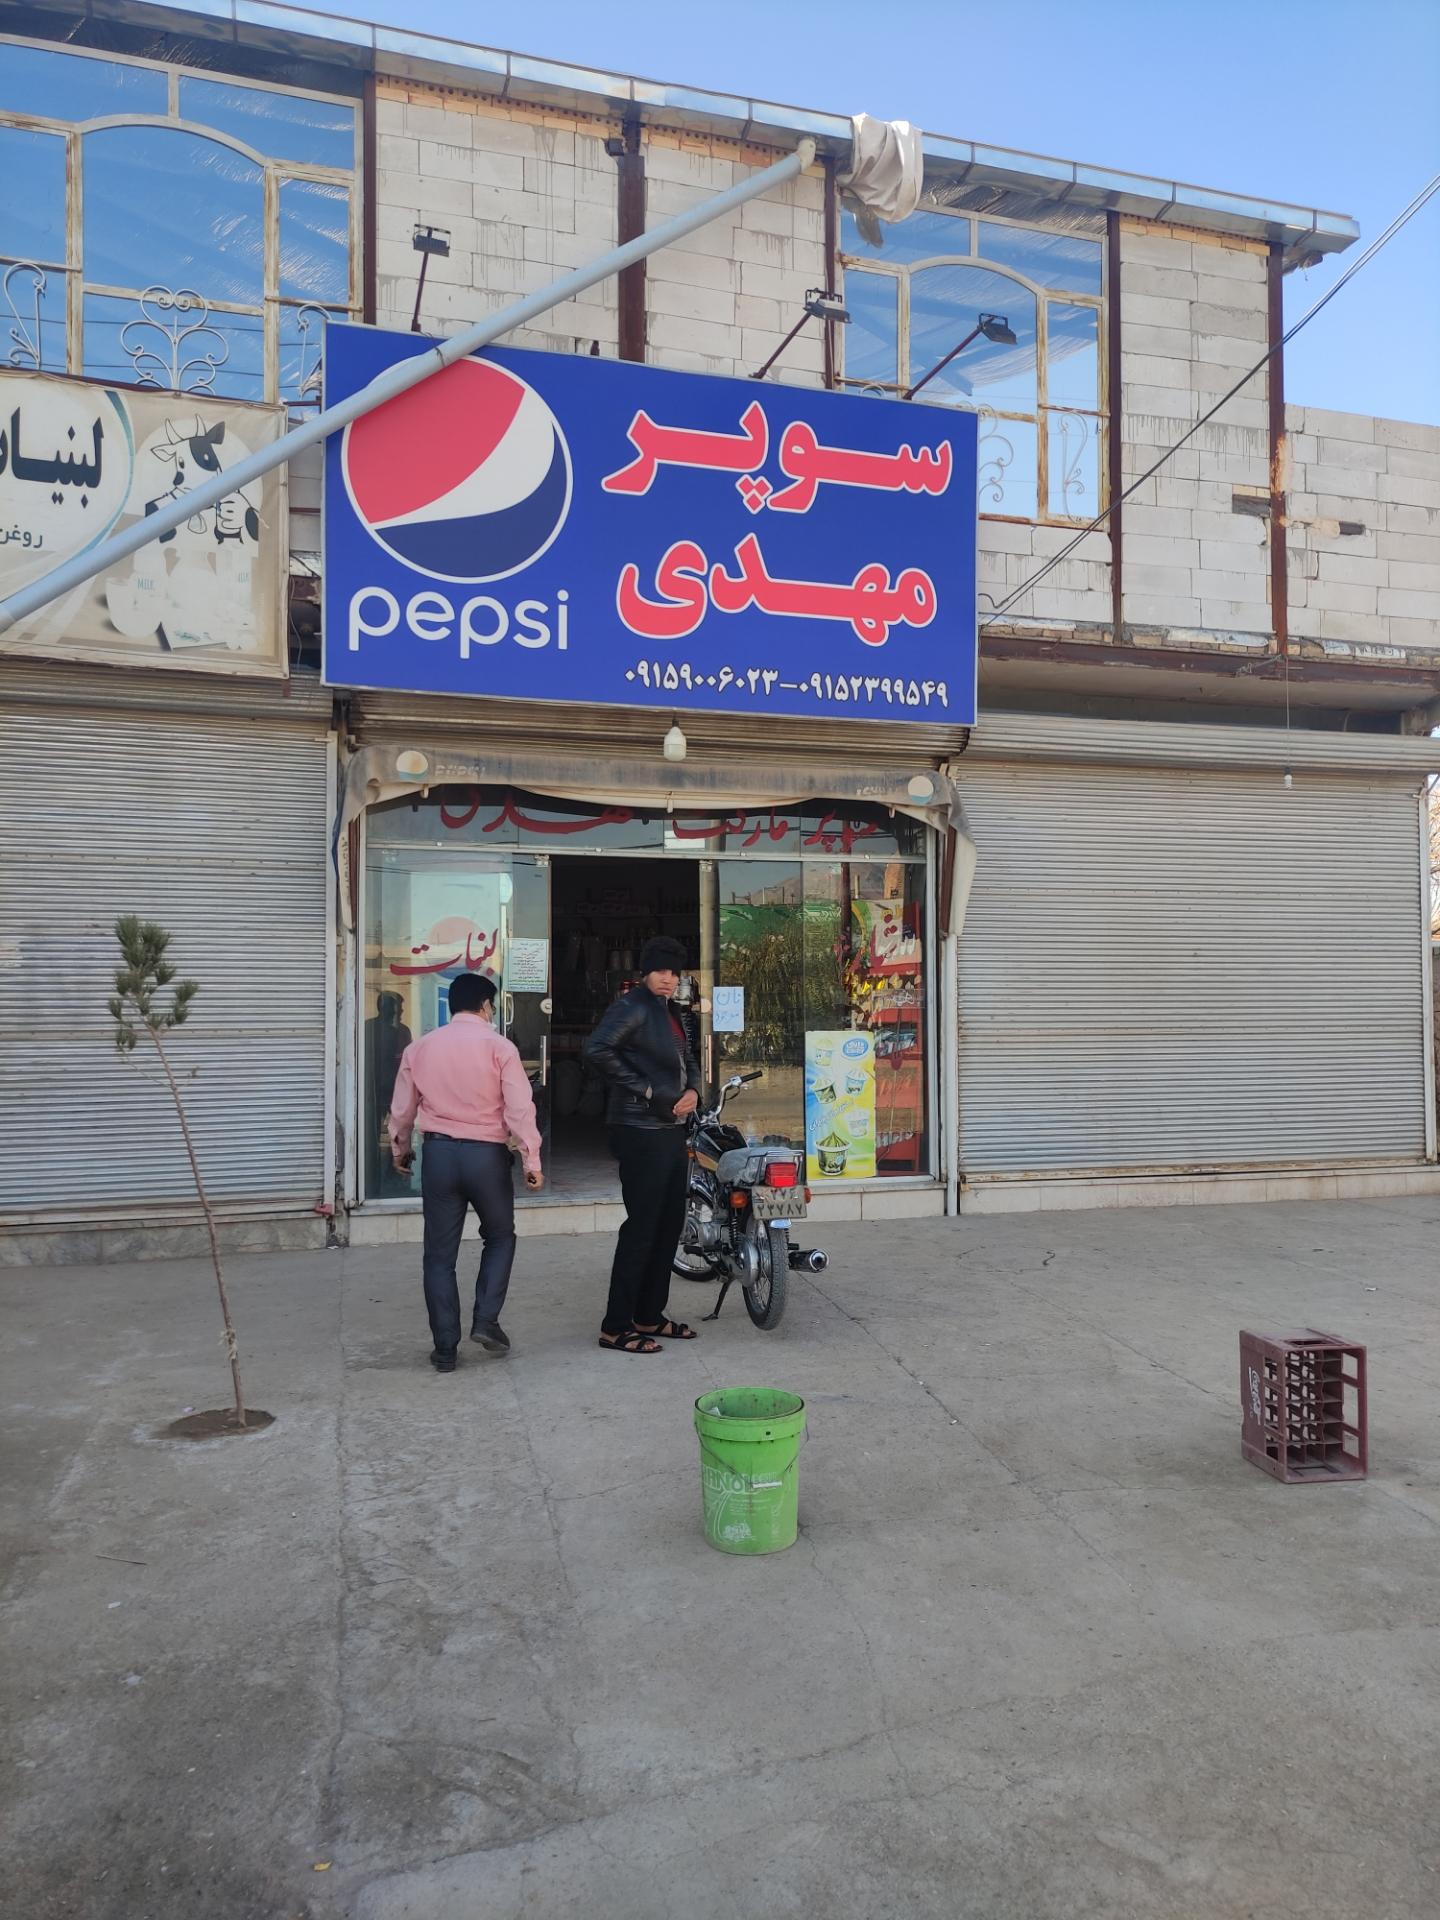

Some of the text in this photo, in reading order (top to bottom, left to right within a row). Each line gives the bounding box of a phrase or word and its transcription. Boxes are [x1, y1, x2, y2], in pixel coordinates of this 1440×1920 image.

[600, 400, 954, 515] سوپر
[348, 586, 570, 659] pepsi
[615, 532, 939, 648] مهدی
